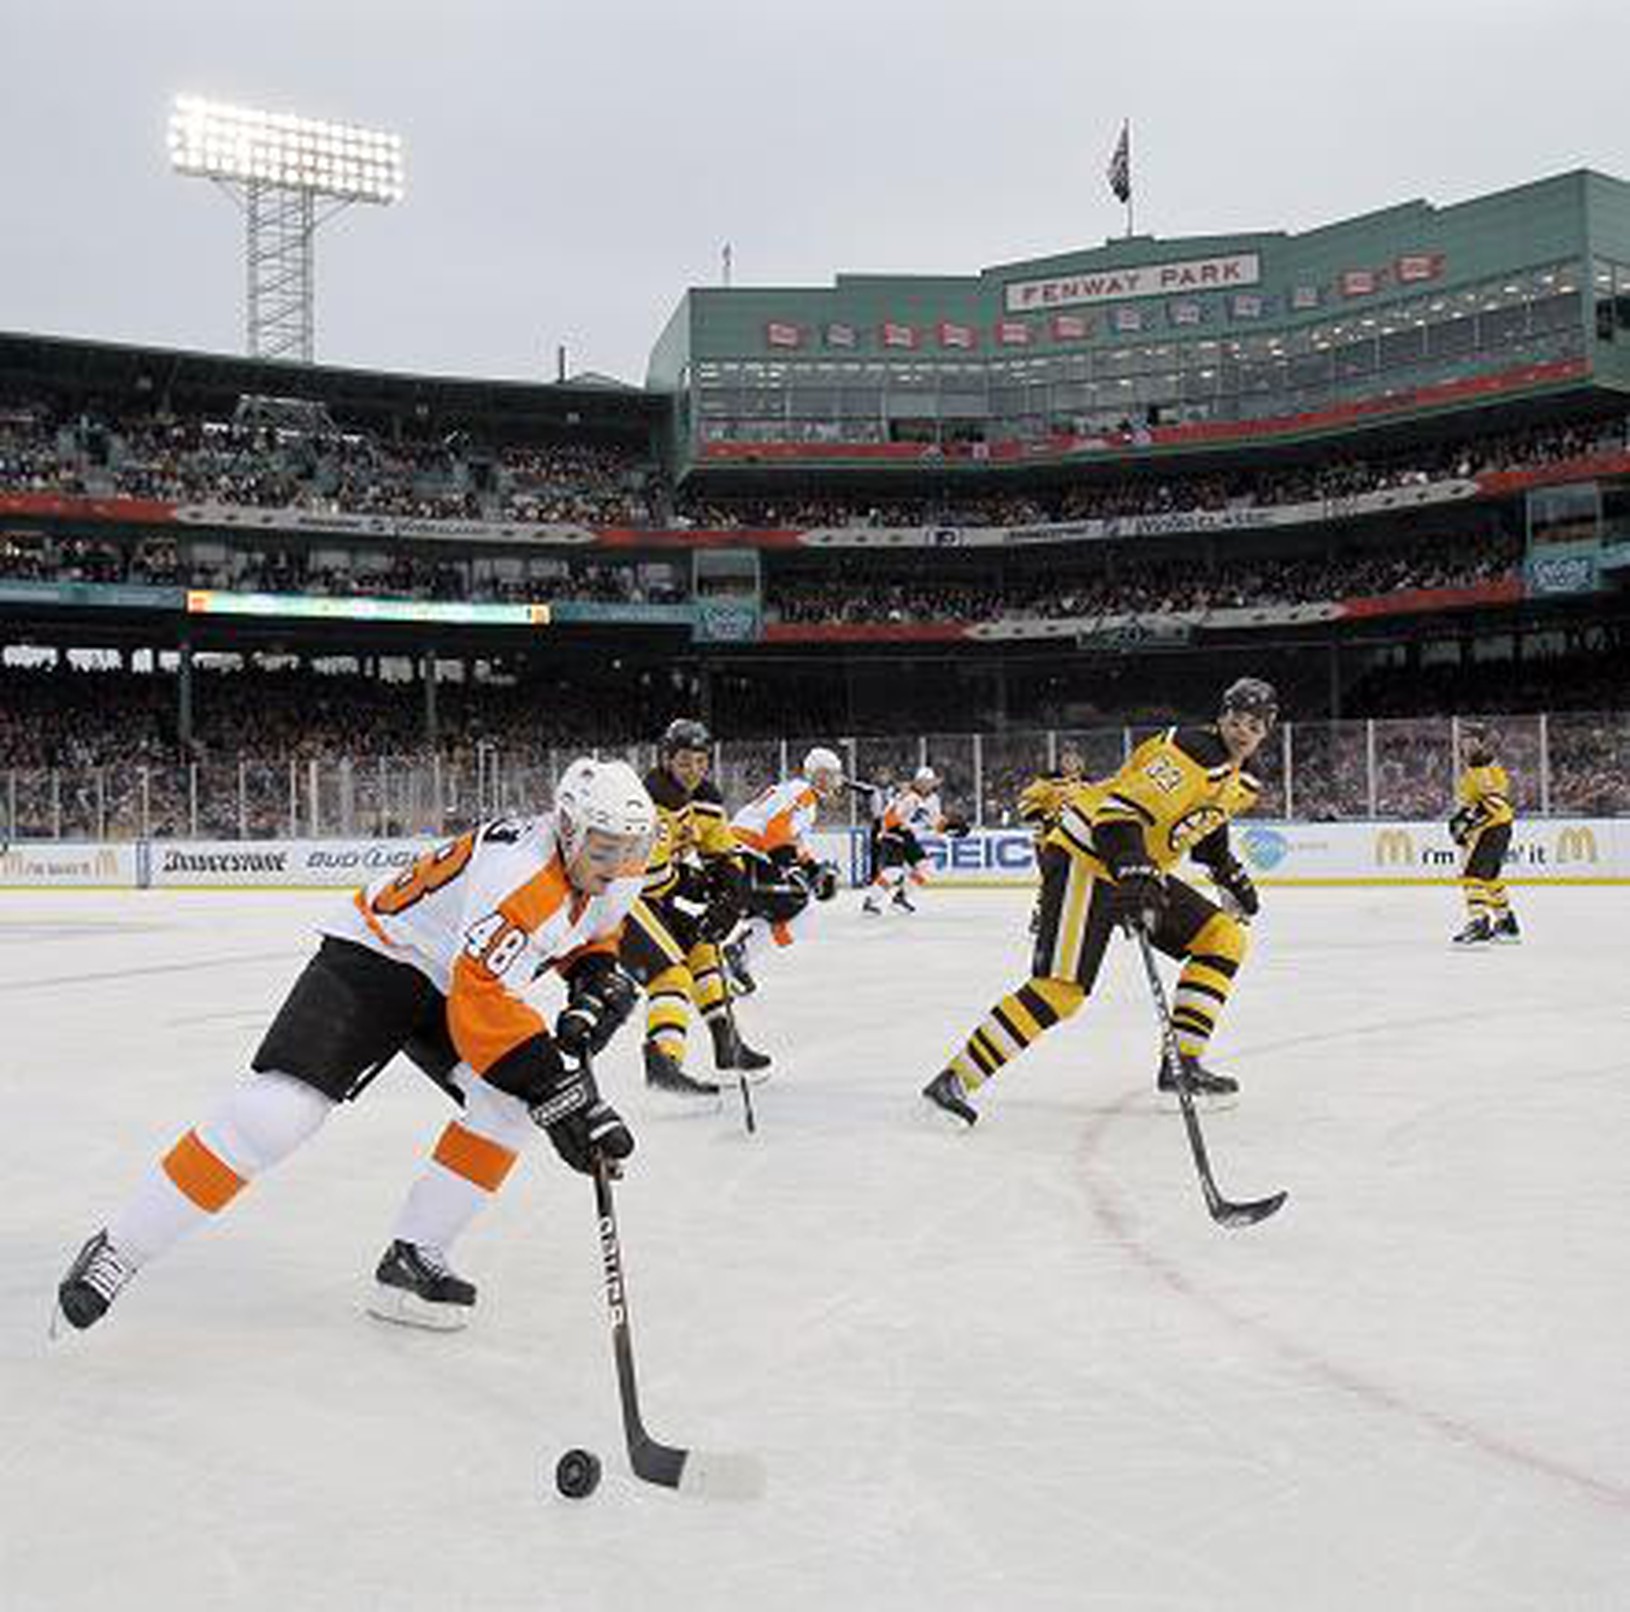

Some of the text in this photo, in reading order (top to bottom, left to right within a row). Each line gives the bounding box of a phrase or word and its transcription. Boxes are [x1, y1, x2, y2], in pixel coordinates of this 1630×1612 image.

[1020, 261, 1242, 305] FENWAY PARK
[920, 837, 1033, 868] GEIC
[464, 910, 528, 979] 48
